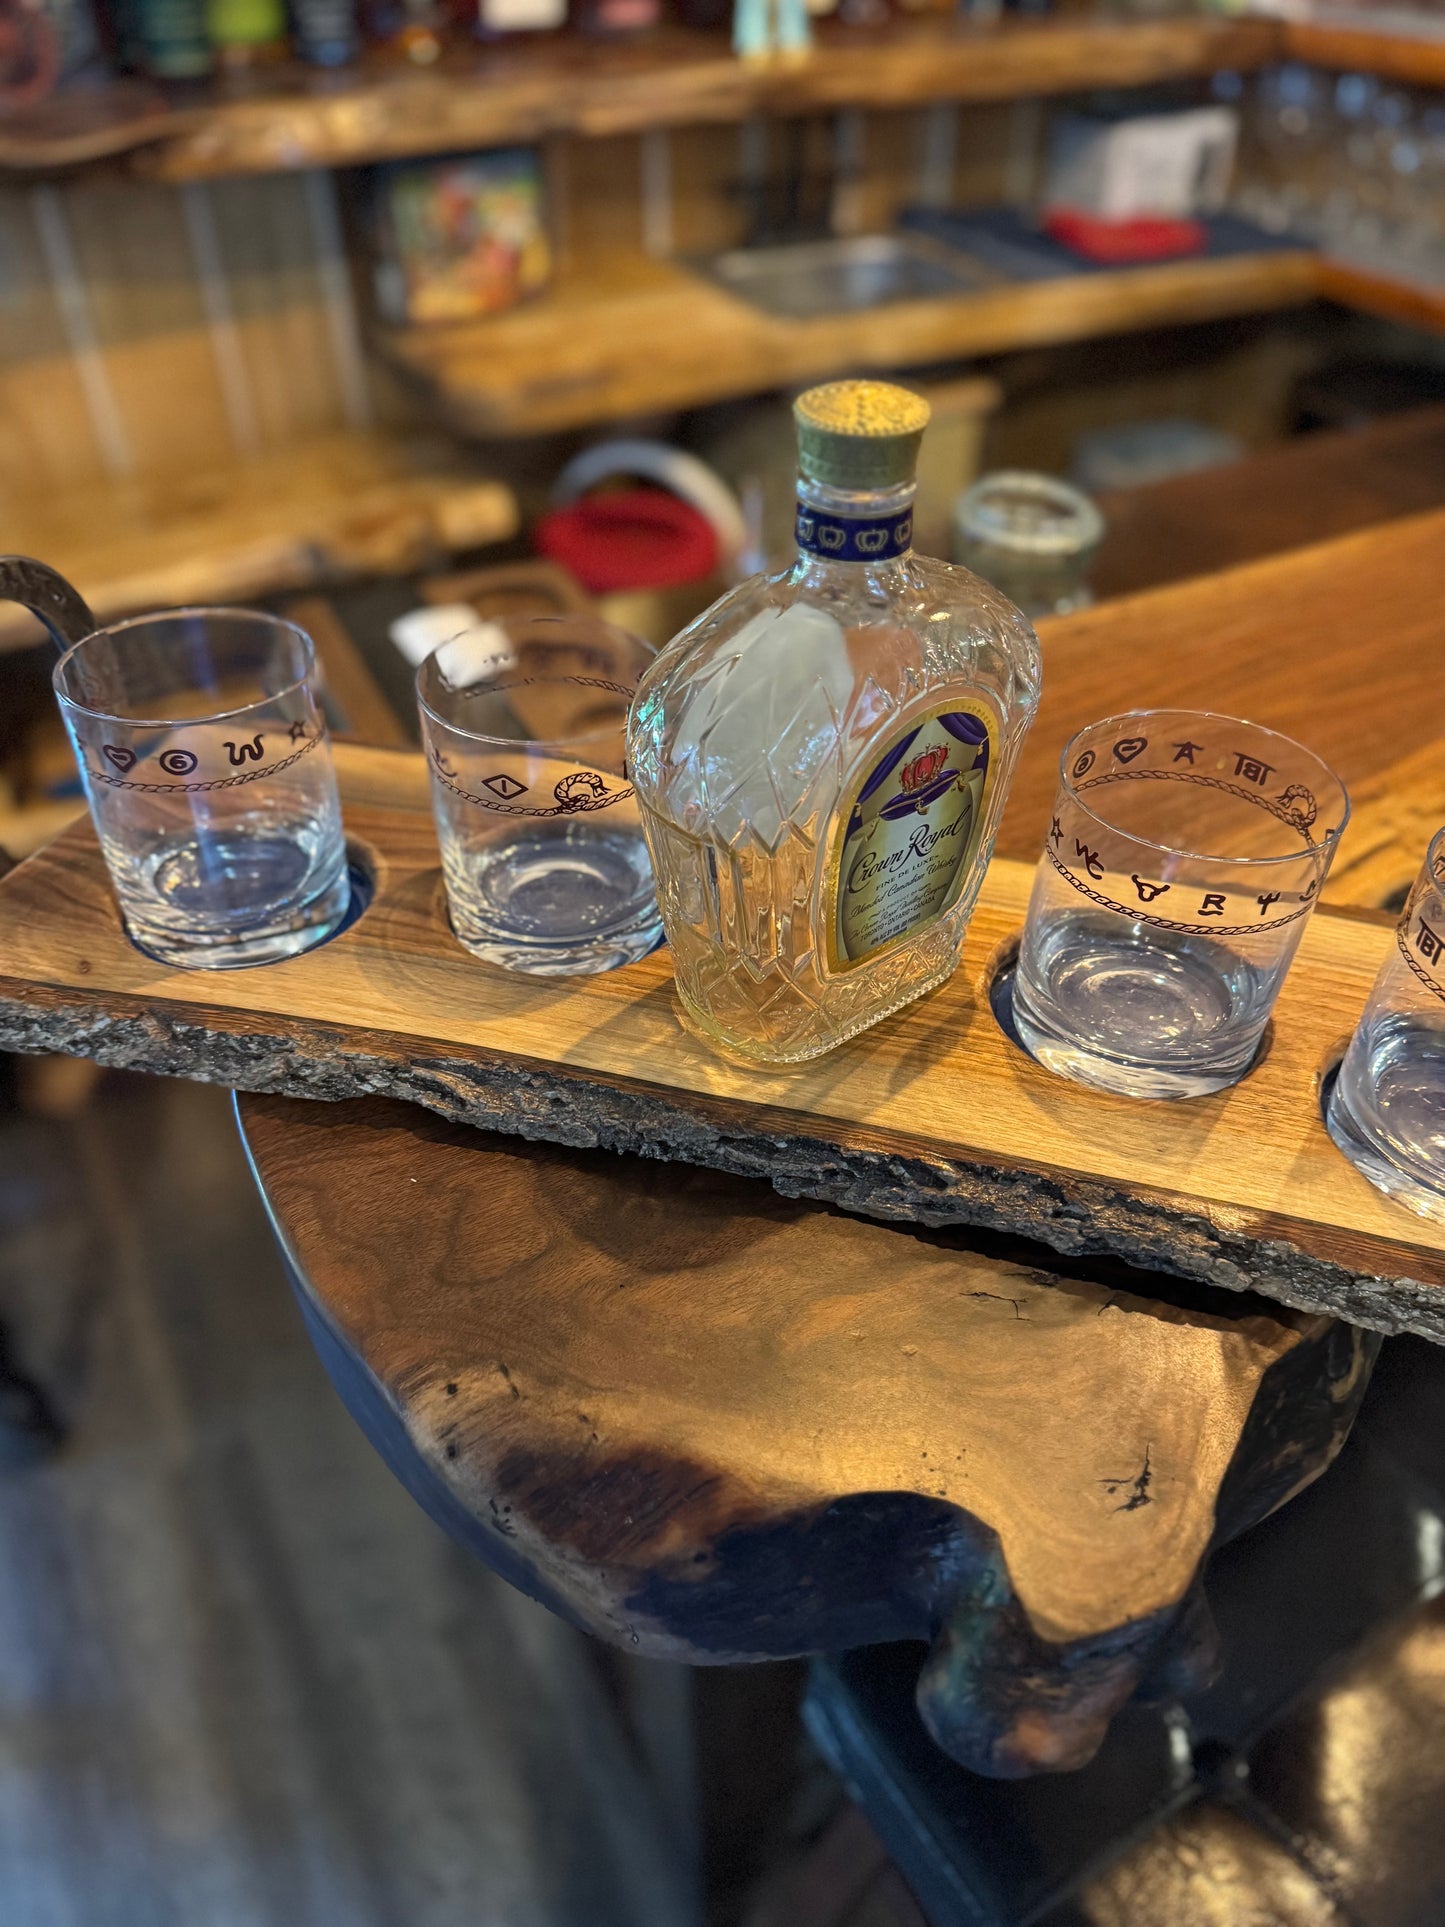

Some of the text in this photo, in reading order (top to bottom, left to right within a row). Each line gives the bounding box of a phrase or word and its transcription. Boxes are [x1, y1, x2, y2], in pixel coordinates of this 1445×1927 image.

[848, 804, 971, 893] Crown Royal
[849, 890, 889, 920] Blended
[887, 873, 925, 896] Canadian
[876, 877, 896, 891] FINE
[898, 870, 910, 879] DE
